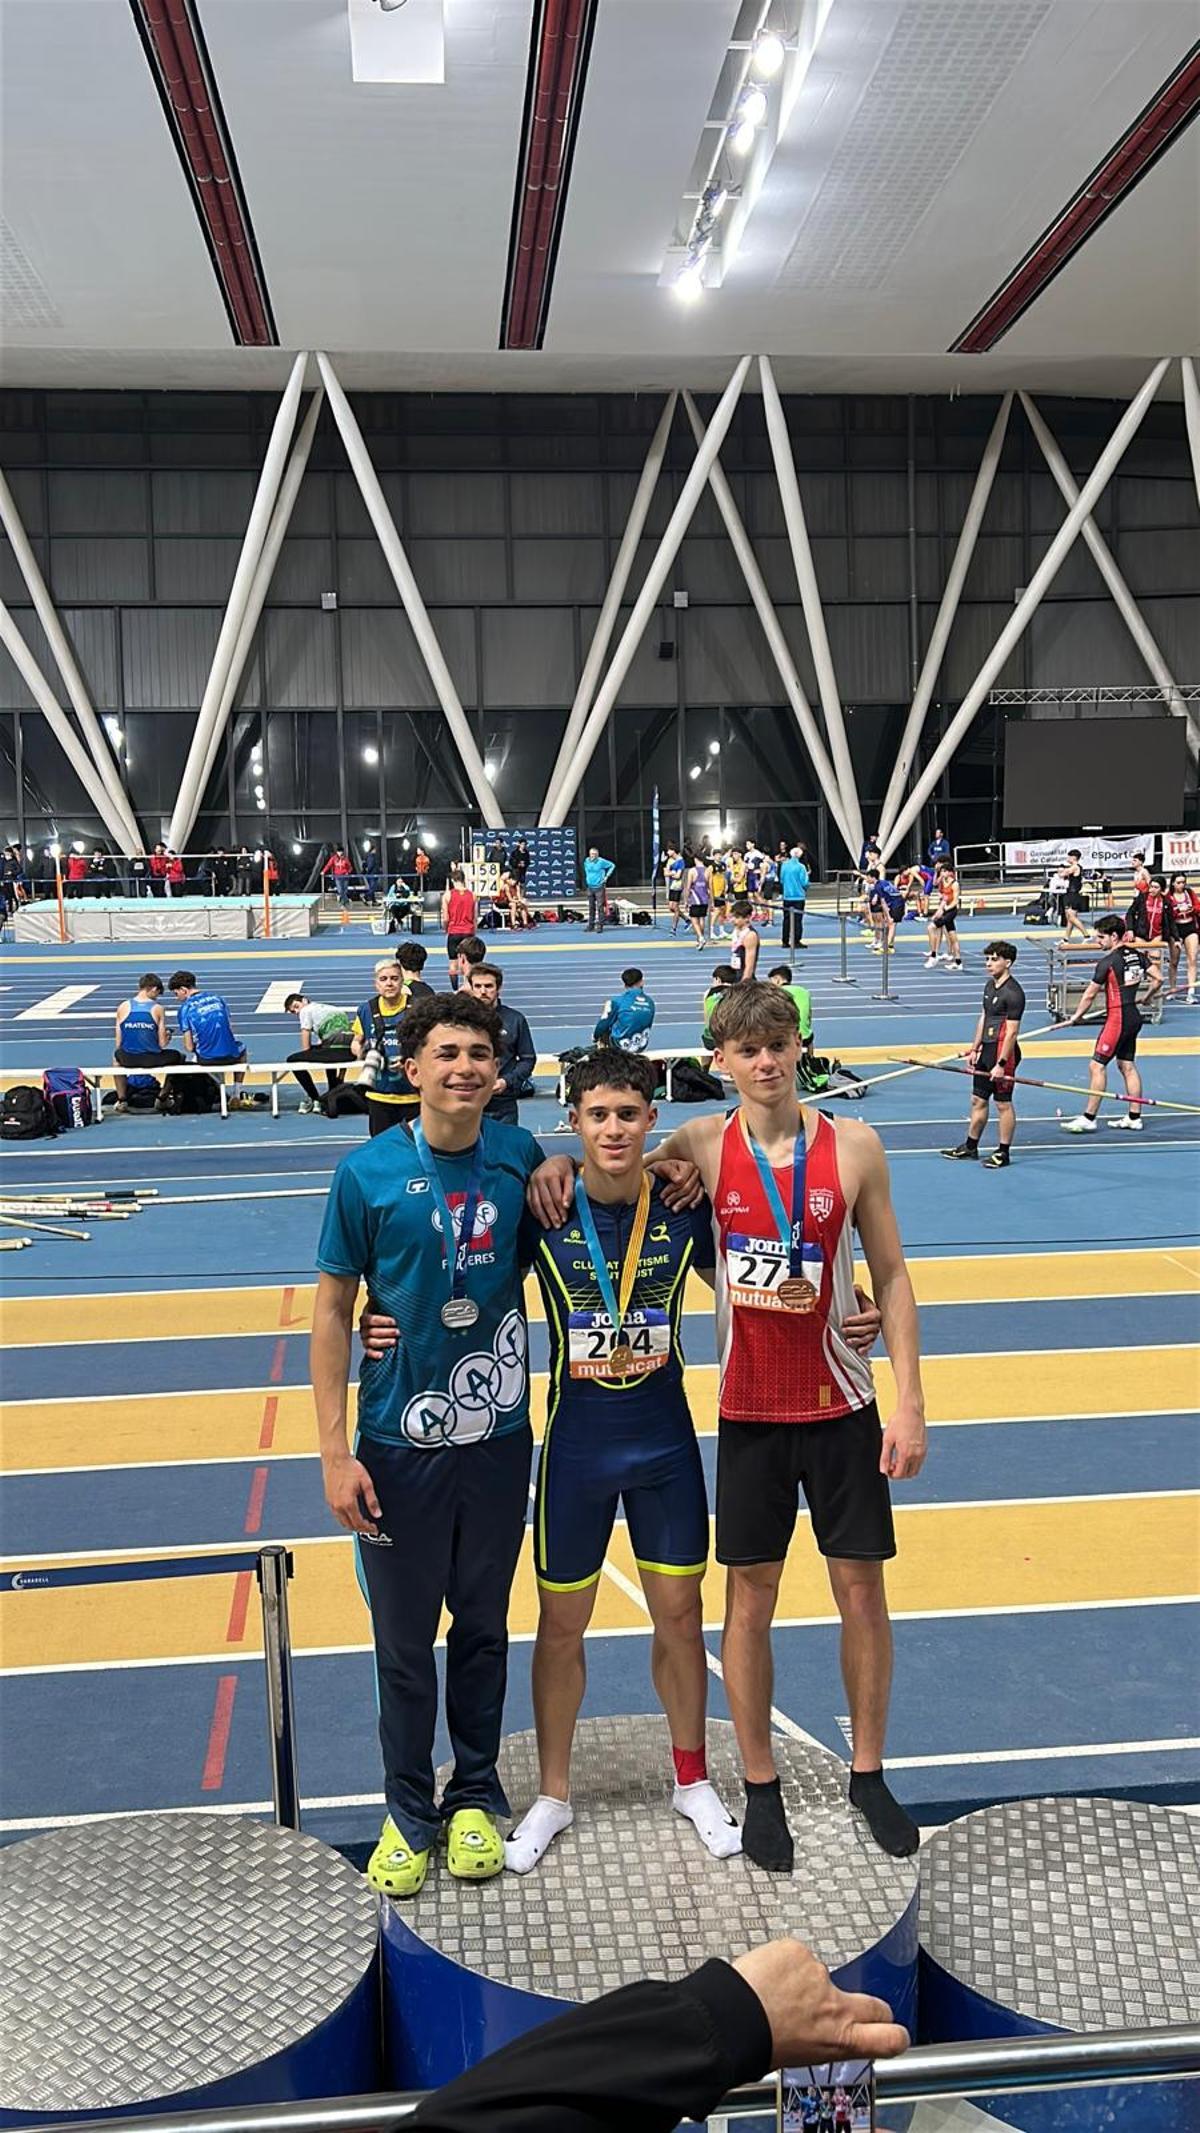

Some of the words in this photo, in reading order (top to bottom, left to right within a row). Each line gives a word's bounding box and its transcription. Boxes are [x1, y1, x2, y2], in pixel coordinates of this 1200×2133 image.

[472, 863, 498, 876] 158
[471, 879, 498, 892] 174
[745, 1237, 788, 1255] Jom
[442, 1251, 496, 1270] FERES
[572, 1260, 596, 1270] CLU
[606, 1254, 671, 1270] ATTISME
